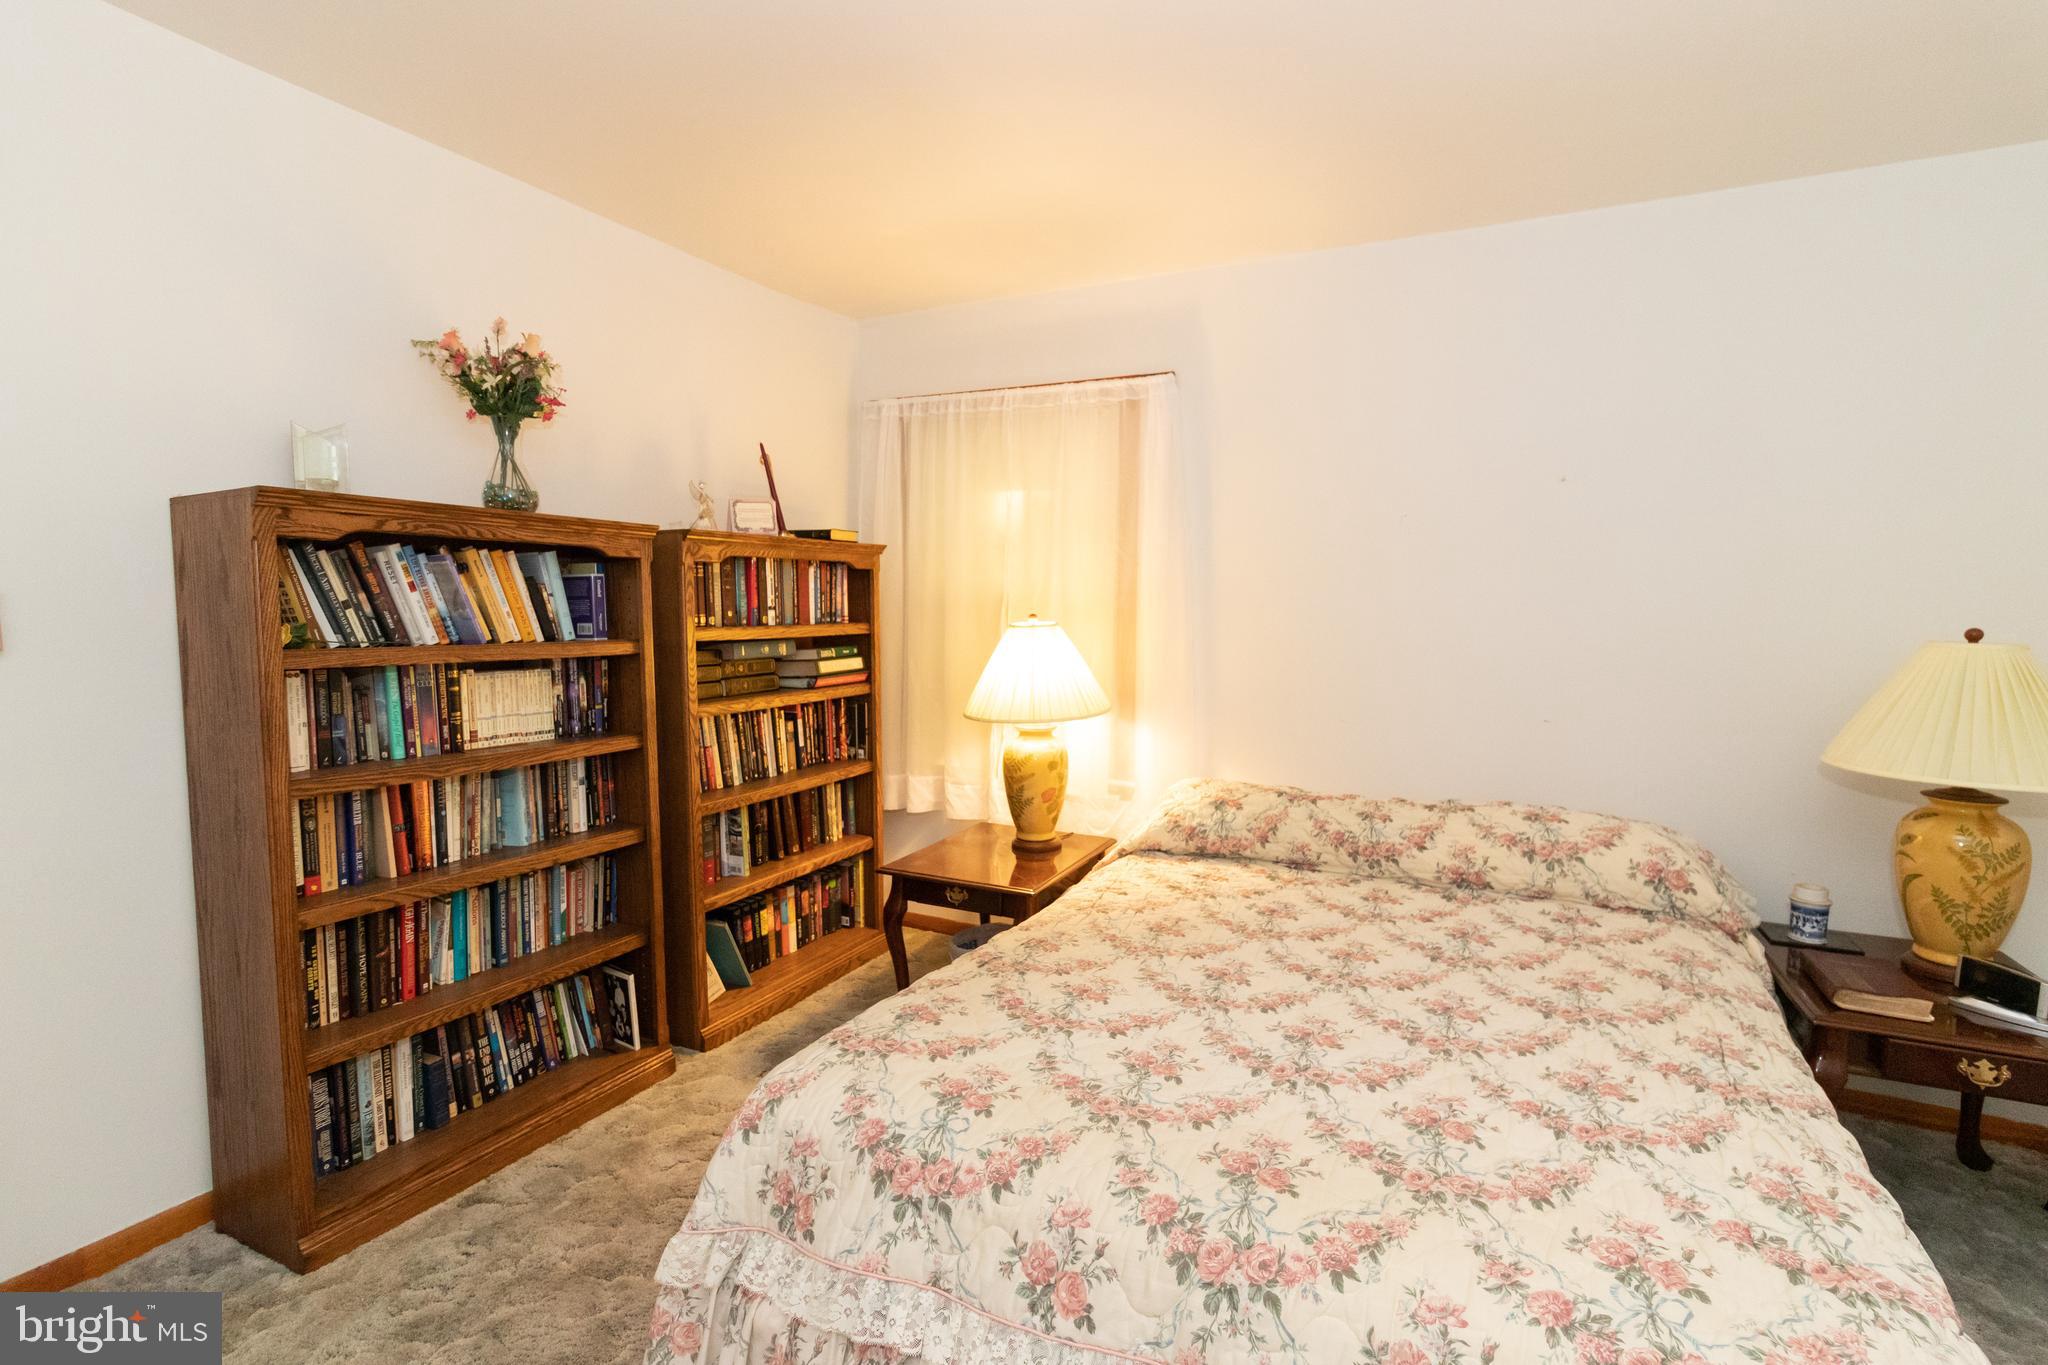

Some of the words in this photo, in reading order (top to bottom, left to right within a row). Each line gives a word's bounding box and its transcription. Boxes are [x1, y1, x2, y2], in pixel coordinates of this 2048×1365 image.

[384, 560, 399, 585] RESET
[305, 544, 321, 571] Where
[320, 577, 331, 591] Am
[336, 607, 352, 633] GRAHAM
[359, 955, 367, 975] HOPE
[478, 1036, 489, 1048] THE
[482, 1064, 493, 1076] THE
